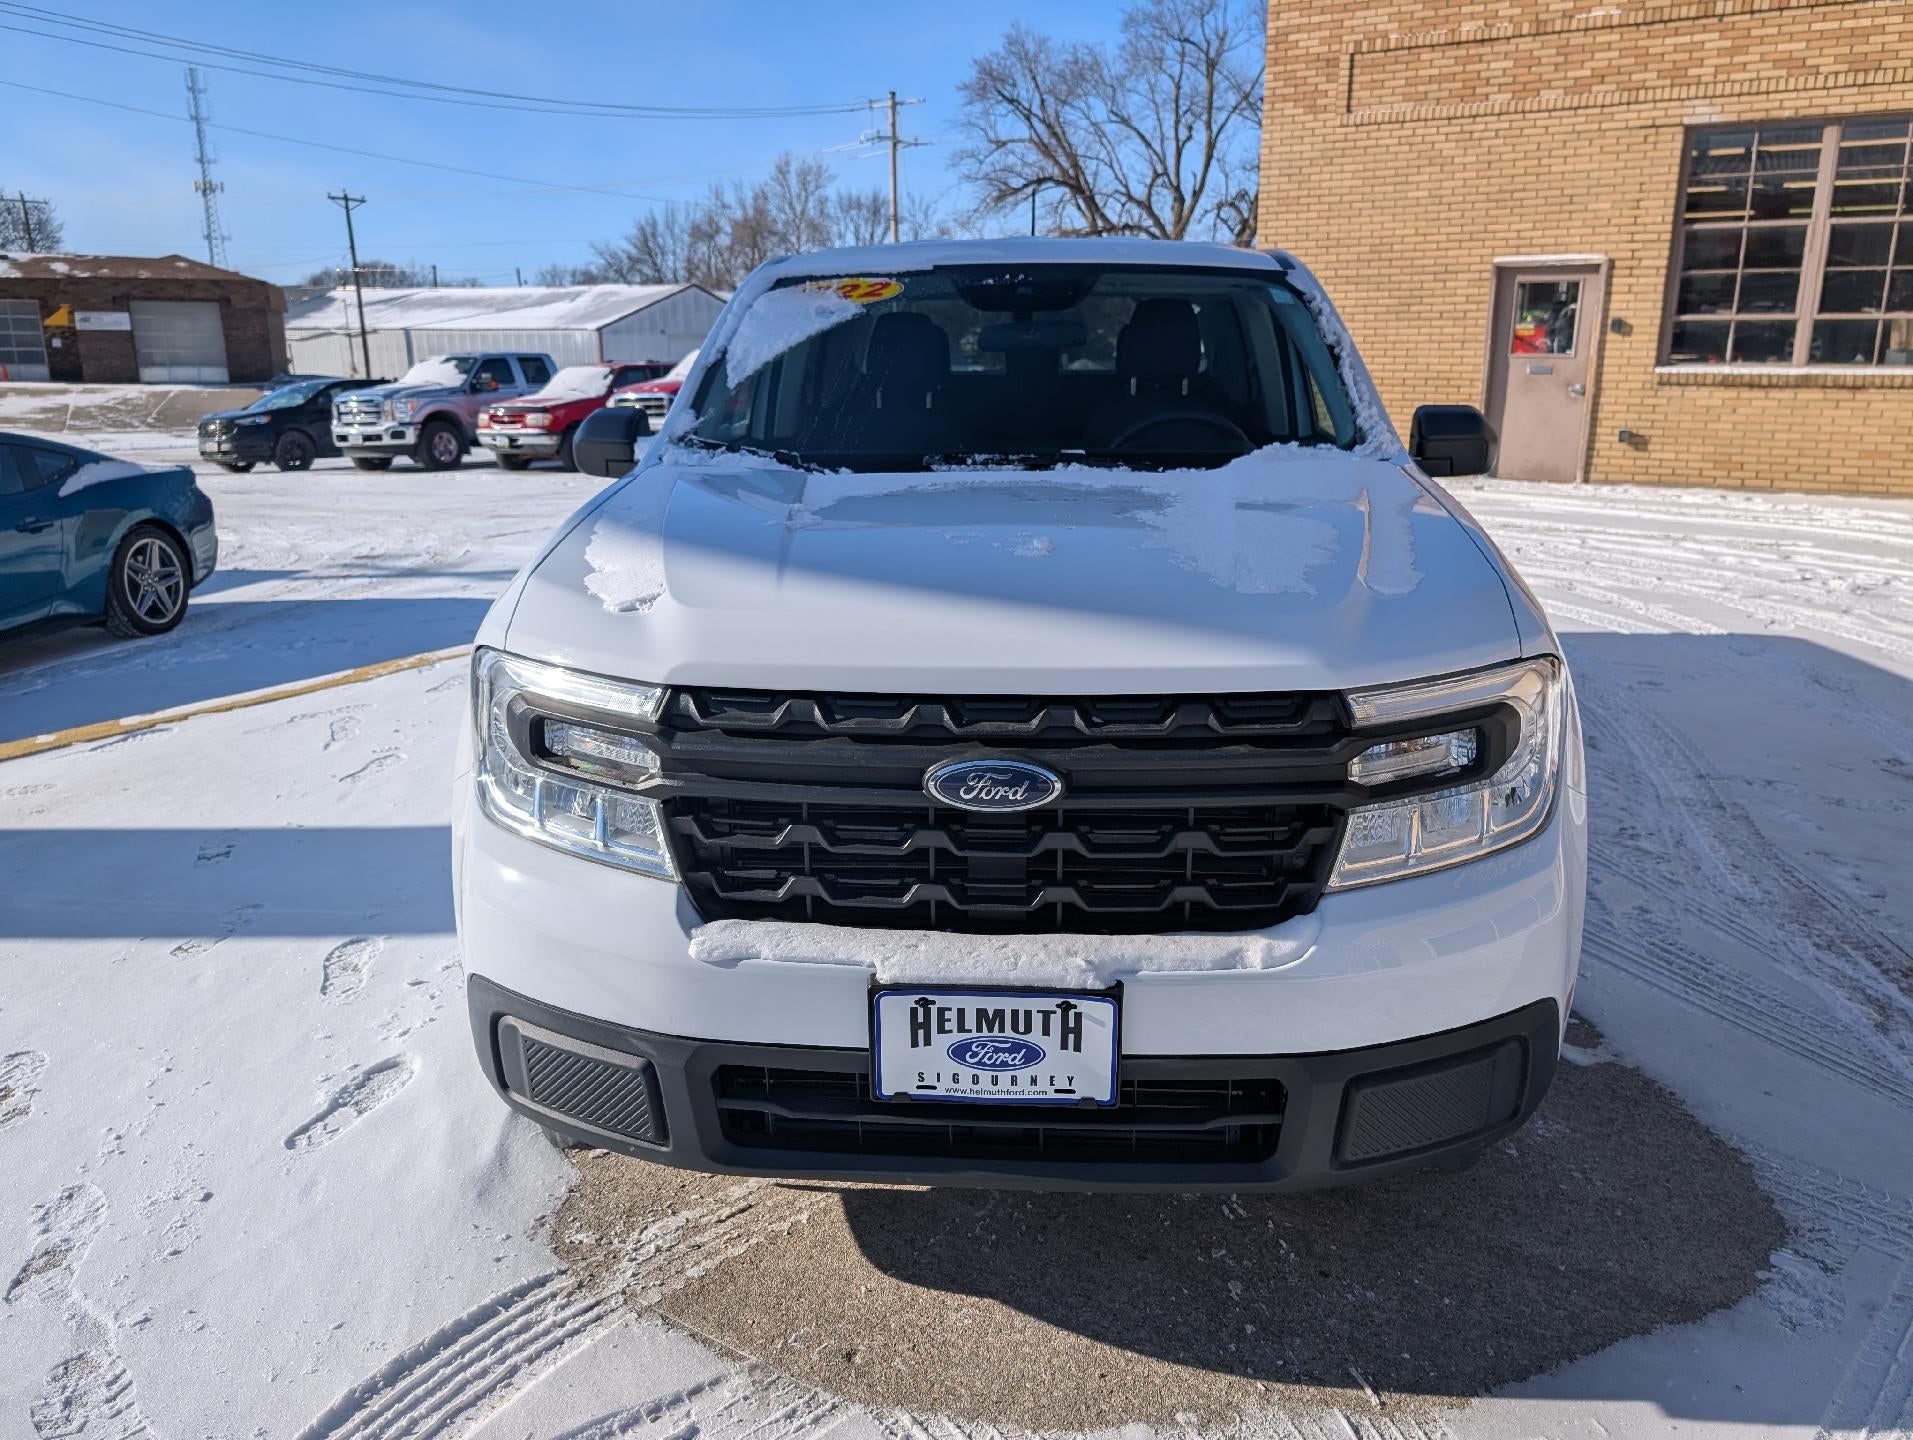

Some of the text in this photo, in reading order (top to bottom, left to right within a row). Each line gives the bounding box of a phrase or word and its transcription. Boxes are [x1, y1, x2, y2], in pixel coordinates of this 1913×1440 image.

[959, 772, 1030, 801] Ford
[909, 1006, 1083, 1053] HELMUTH
[965, 1041, 1026, 1065] Ford
[917, 1071, 1075, 1087] SIGOURNEY
[944, 1087, 1048, 1096] www.helmuthford.com
